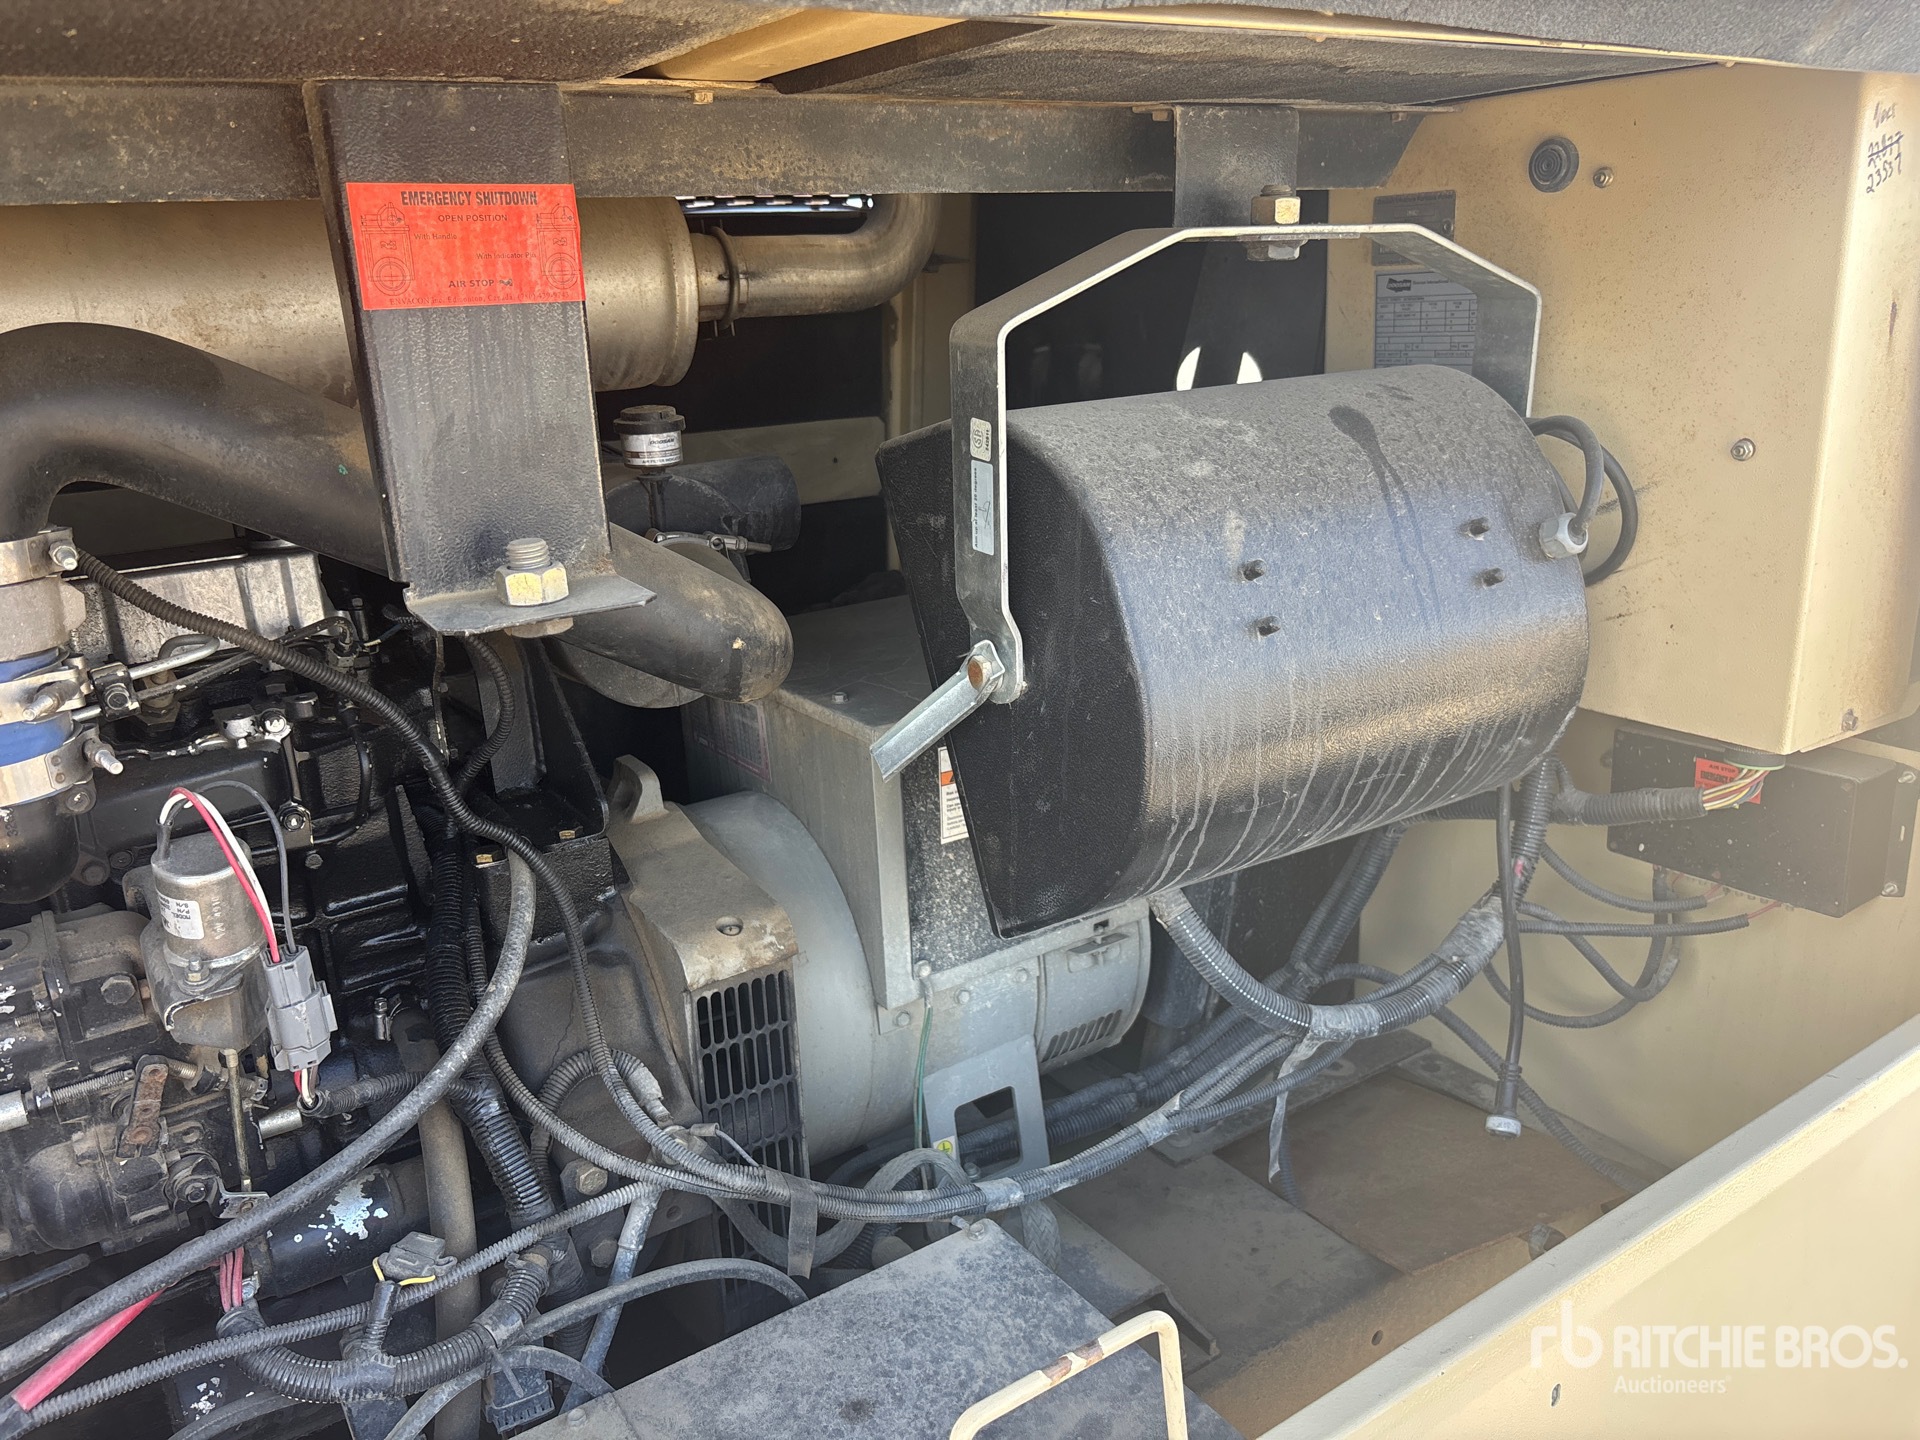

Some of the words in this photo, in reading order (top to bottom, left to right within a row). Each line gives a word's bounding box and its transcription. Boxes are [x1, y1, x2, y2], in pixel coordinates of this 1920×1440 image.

[400, 190, 472, 206] EMERGENCY
[476, 190, 538, 206] SHUTDOWN
[438, 214, 464, 222] OPEN
[466, 214, 508, 222] POSITION
[414, 233, 431, 241] With
[432, 232, 458, 240] Handle
[476, 252, 493, 260] With
[493, 251, 524, 260] Indicator
[448, 280, 467, 289] AIR
[469, 279, 495, 288] STOP
[389, 297, 430, 306] ENVACON
